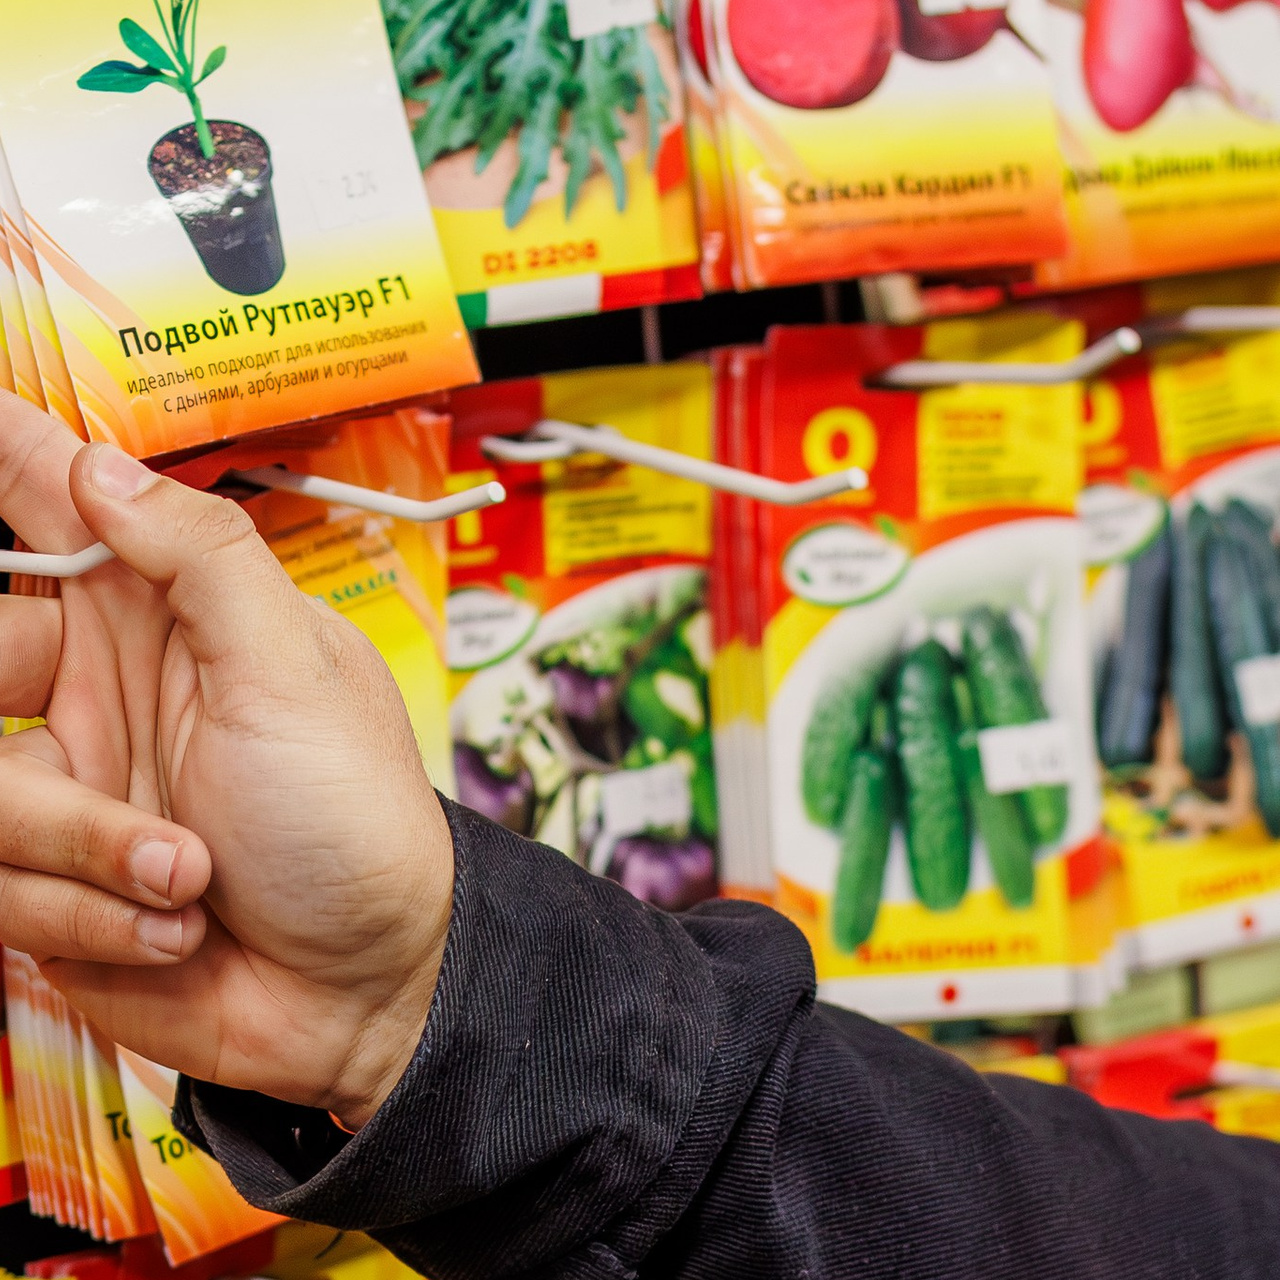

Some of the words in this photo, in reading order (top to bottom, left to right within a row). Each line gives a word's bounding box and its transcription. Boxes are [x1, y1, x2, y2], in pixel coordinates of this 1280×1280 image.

[118, 308, 241, 359] Подвой
[242, 285, 376, 337] Рутпауэр
[376, 274, 412, 306] F1
[126, 364, 205, 394] идеально
[207, 348, 282, 379] подходит
[285, 342, 314, 362] для
[314, 320, 428, 356] использования
[175, 382, 245, 414] дынями,
[246, 366, 320, 396] арбузами
[336, 349, 410, 378] огурцами
